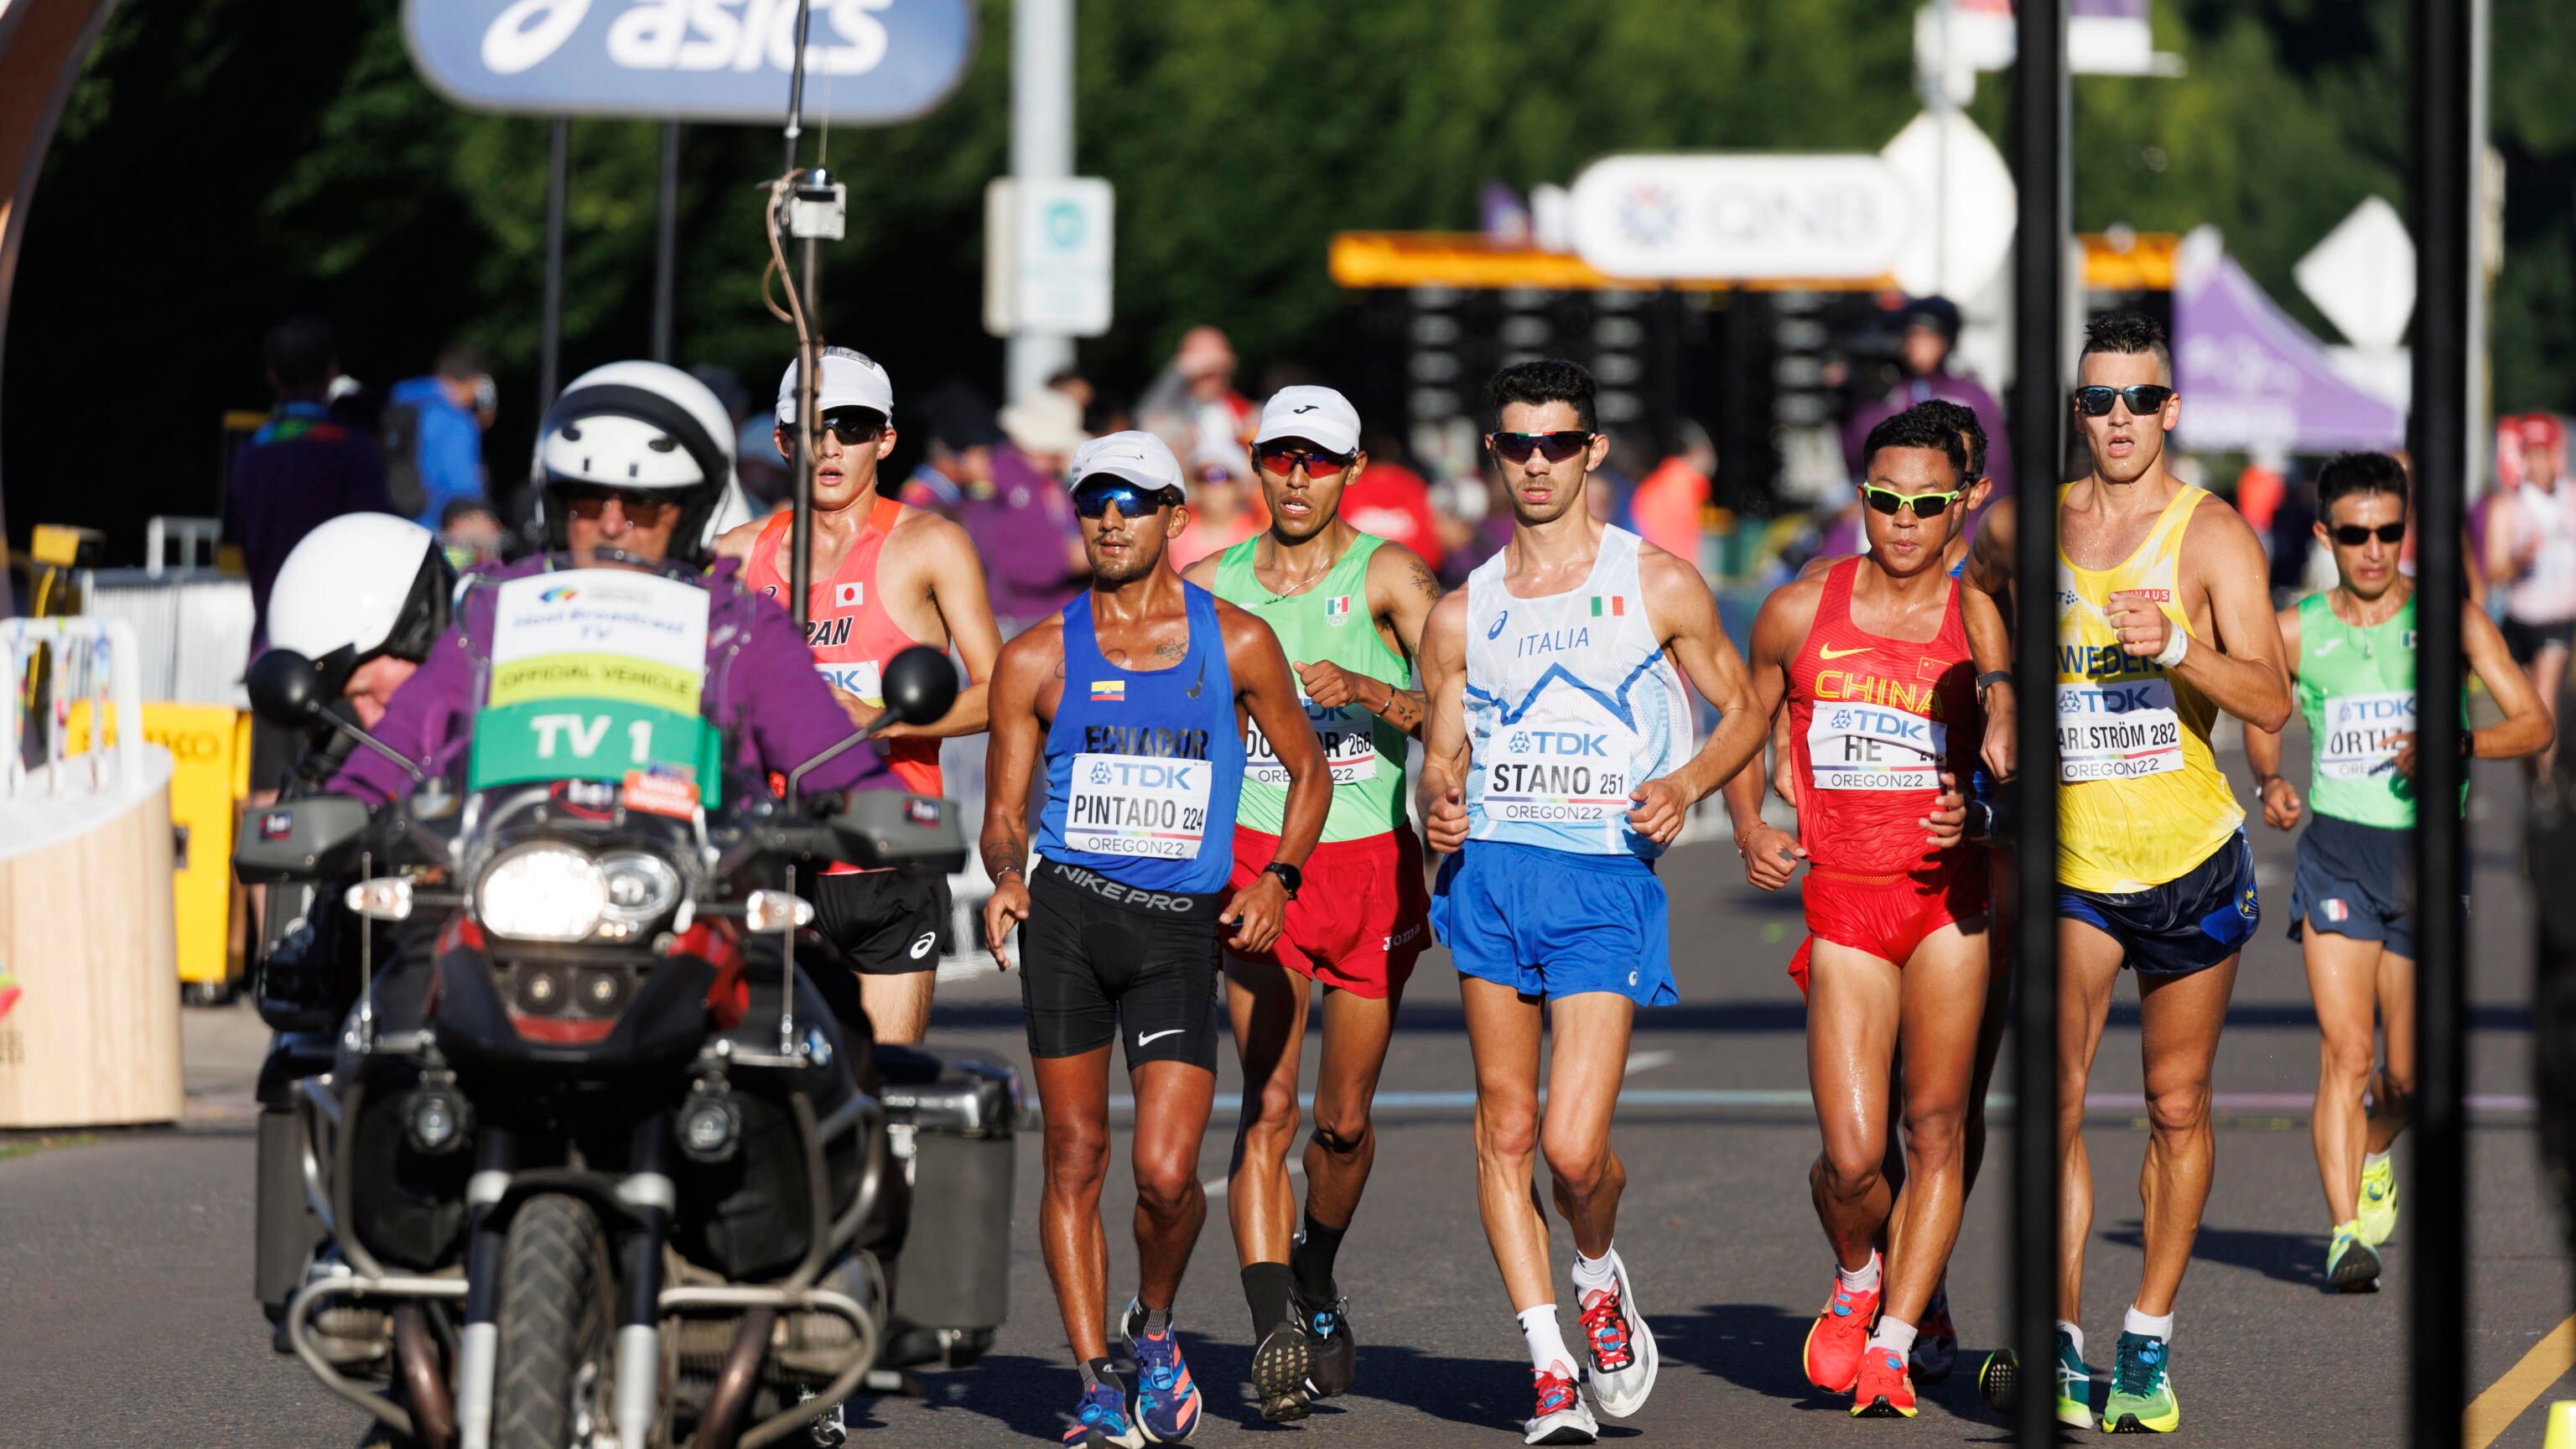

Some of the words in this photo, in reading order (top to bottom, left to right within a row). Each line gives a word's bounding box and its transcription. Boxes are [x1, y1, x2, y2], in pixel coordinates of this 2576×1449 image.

[605, 0, 889, 75] asics
[804, 616, 854, 647] PAN
[1518, 626, 1589, 658] ITALIA
[2057, 645, 2163, 673] WEDEN
[501, 662, 591, 691] OFFICIAL
[602, 664, 691, 695] VEHICLE
[1815, 669, 1945, 719] CHINA
[2080, 687, 2153, 713] TDK
[530, 714, 612, 758] TV
[627, 719, 652, 764] 1
[1853, 709, 1925, 740] TDK
[2058, 722, 2145, 750] ARLSTRÖM
[2150, 722, 2177, 746] 282
[1085, 724, 1209, 761] ECUADOR
[1348, 730, 1372, 756] 266
[1531, 731, 1609, 756] TDK
[1845, 735, 1883, 762] HE
[1114, 762, 1192, 790] TDK
[1493, 764, 1592, 795] STANO
[1600, 773, 1624, 796] 251
[1831, 774, 1924, 787] OREGON22
[2064, 758, 2160, 778] OREGON22
[1073, 795, 1176, 828] PINTADO
[1182, 807, 1204, 831] 224
[1506, 805, 1602, 820] OREGON22
[1088, 837, 1184, 856] OREGON22
[1053, 864, 1122, 901] NIKE
[1124, 889, 1194, 913] PRO
